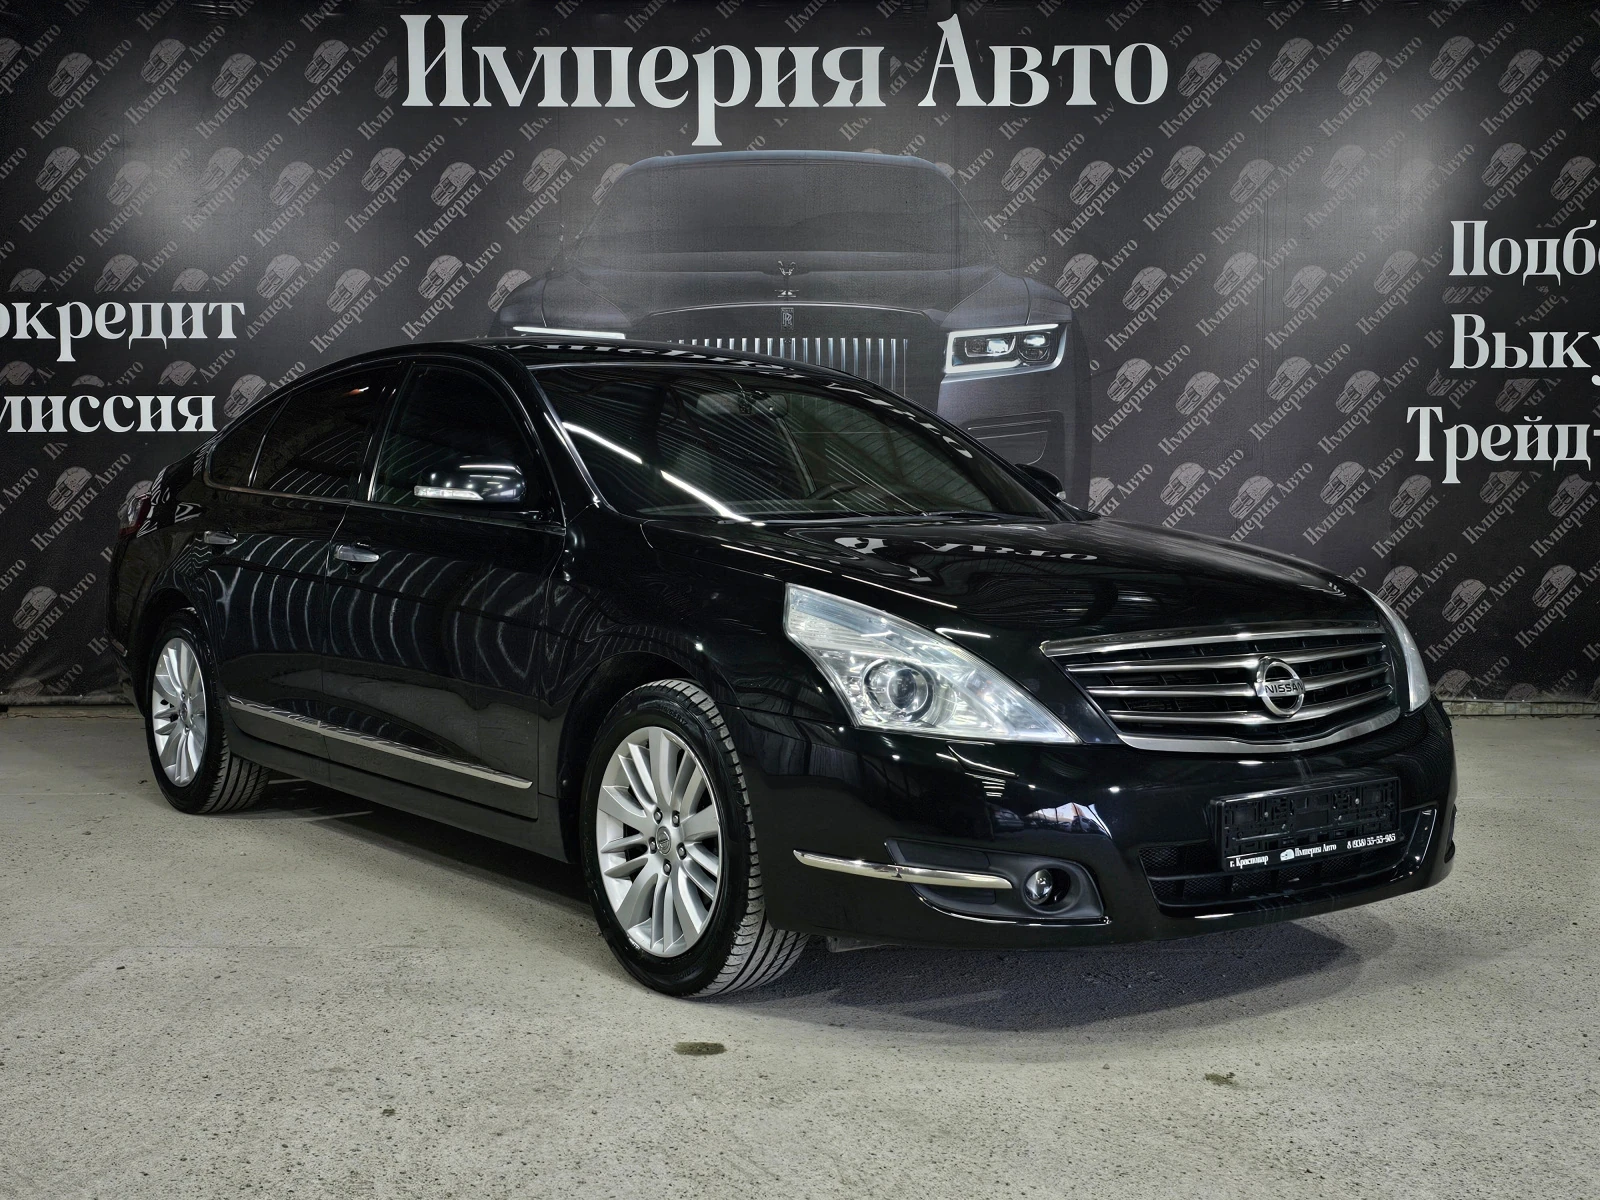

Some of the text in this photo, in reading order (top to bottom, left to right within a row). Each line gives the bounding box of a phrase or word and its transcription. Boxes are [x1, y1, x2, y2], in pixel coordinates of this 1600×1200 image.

[23, 24, 61, 61] Авто
[30, 74, 99, 140] Империя
[95, 39, 132, 76] Авто
[124, 25, 225, 125] Империя Авто
[195, 74, 263, 140] Империя
[259, 39, 296, 76] Авто
[288, 60, 355, 126] Империя
[352, 25, 388, 62] Авто
[401, 14, 1168, 146] Империя Авто
[1158, 39, 1262, 139] Империя Авто
[1250, 23, 1353, 124] Империя Авто
[1318, 37, 1422, 137] Империя Авто
[1410, 22, 1515, 122] Империя Авто
[1480, 70, 1549, 136] Империя
[1546, 36, 1584, 73] Авто
[18, 133, 120, 233] Империя Авто
[247, 133, 283, 170] Авто
[252, 148, 353, 248] Империя Авто
[344, 134, 445, 234] Империя Авто
[413, 149, 515, 248] Империя Авто
[505, 134, 607, 234] Империя Авто
[956, 148, 994, 185] Авто
[983, 168, 1051, 234] Империя
[1047, 133, 1085, 170] Авто
[1051, 146, 1154, 247] Империя Авто
[1142, 132, 1246, 232] Империя Авто
[1211, 146, 1315, 244] Империя Авто
[1482, 129, 1566, 211] перия Авто
[49, 255, 85, 292] Авто
[141, 241, 179, 277] Авто
[211, 254, 249, 291] Авто
[304, 241, 340, 278] Авто
[400, 241, 502, 340] Империя Авто
[1069, 239, 1138, 310] ерия Авто
[1196, 237, 1298, 337] Империя Авто
[1264, 252, 1367, 351] Империя Авто
[1449, 220, 1600, 285] Подб
[310, 255, 410, 354] Империя Авто
[1103, 253, 1207, 352] Империя Авто
[1355, 270, 1424, 336] Империя
[1450, 314, 1600, 385] Вык
[199, 348, 236, 383] Авто
[1155, 345, 1191, 381] Авто
[1157, 358, 1259, 456] Империя Авто
[1249, 343, 1350, 441] Империя Авто
[1317, 356, 1419, 454] Империя Авто
[1, 467, 39, 504] Авто
[30, 452, 132, 552] Империя Авто
[1117, 463, 1153, 499] Авто
[1162, 483, 1211, 529] перия
[1207, 449, 1244, 485] Авто
[1230, 463, 1313, 542] перия Авто
[1302, 448, 1404, 546] Империя Авто
[1371, 494, 1440, 559] Империя
[1462, 480, 1530, 544] Империя
[1530, 493, 1599, 558] Империя
[60, 572, 97, 609] Авто
[1421, 552, 1457, 588] Авто
[1424, 599, 1492, 663] Империя
[1489, 565, 1526, 602] Авто
[1514, 584, 1583, 650] Империя
[1265, 682, 1304, 694] NISSAN
[1346, 841, 1352, 849] 8
